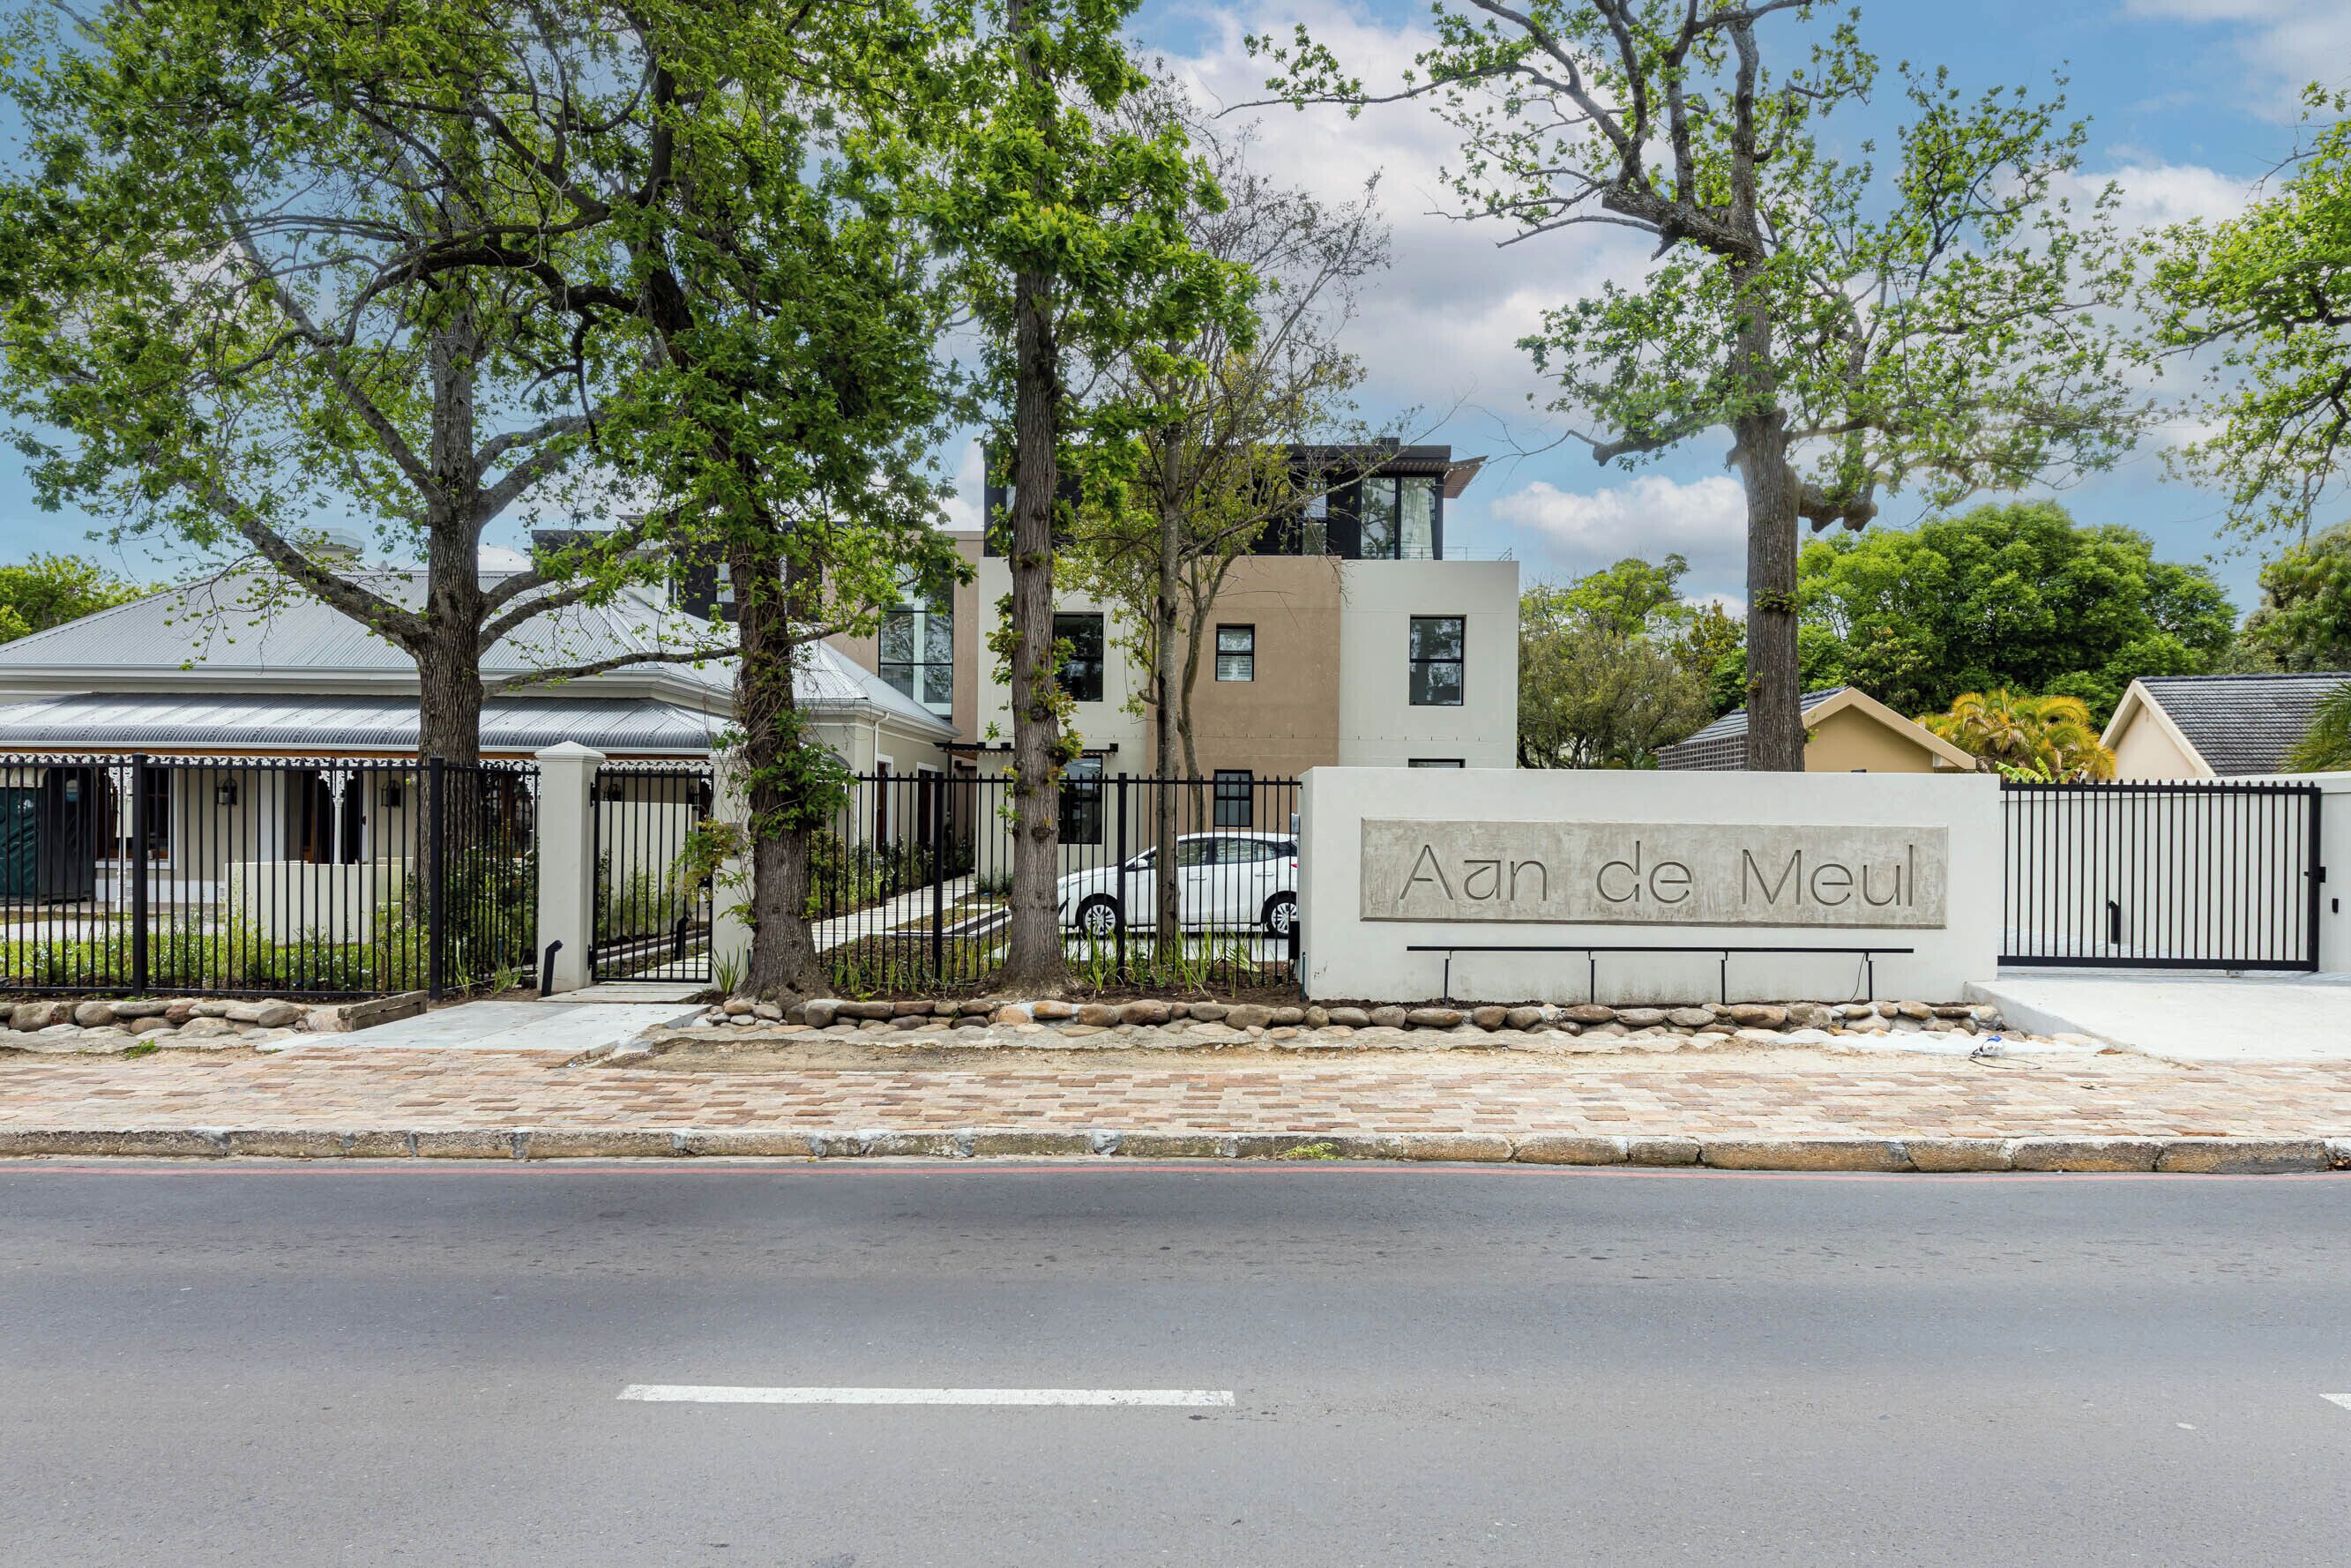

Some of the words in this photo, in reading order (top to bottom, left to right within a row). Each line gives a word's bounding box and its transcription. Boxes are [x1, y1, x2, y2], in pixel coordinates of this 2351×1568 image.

[1399, 844, 1548, 901] Aan
[1597, 840, 1693, 904] de
[1742, 844, 1914, 907] Meul
